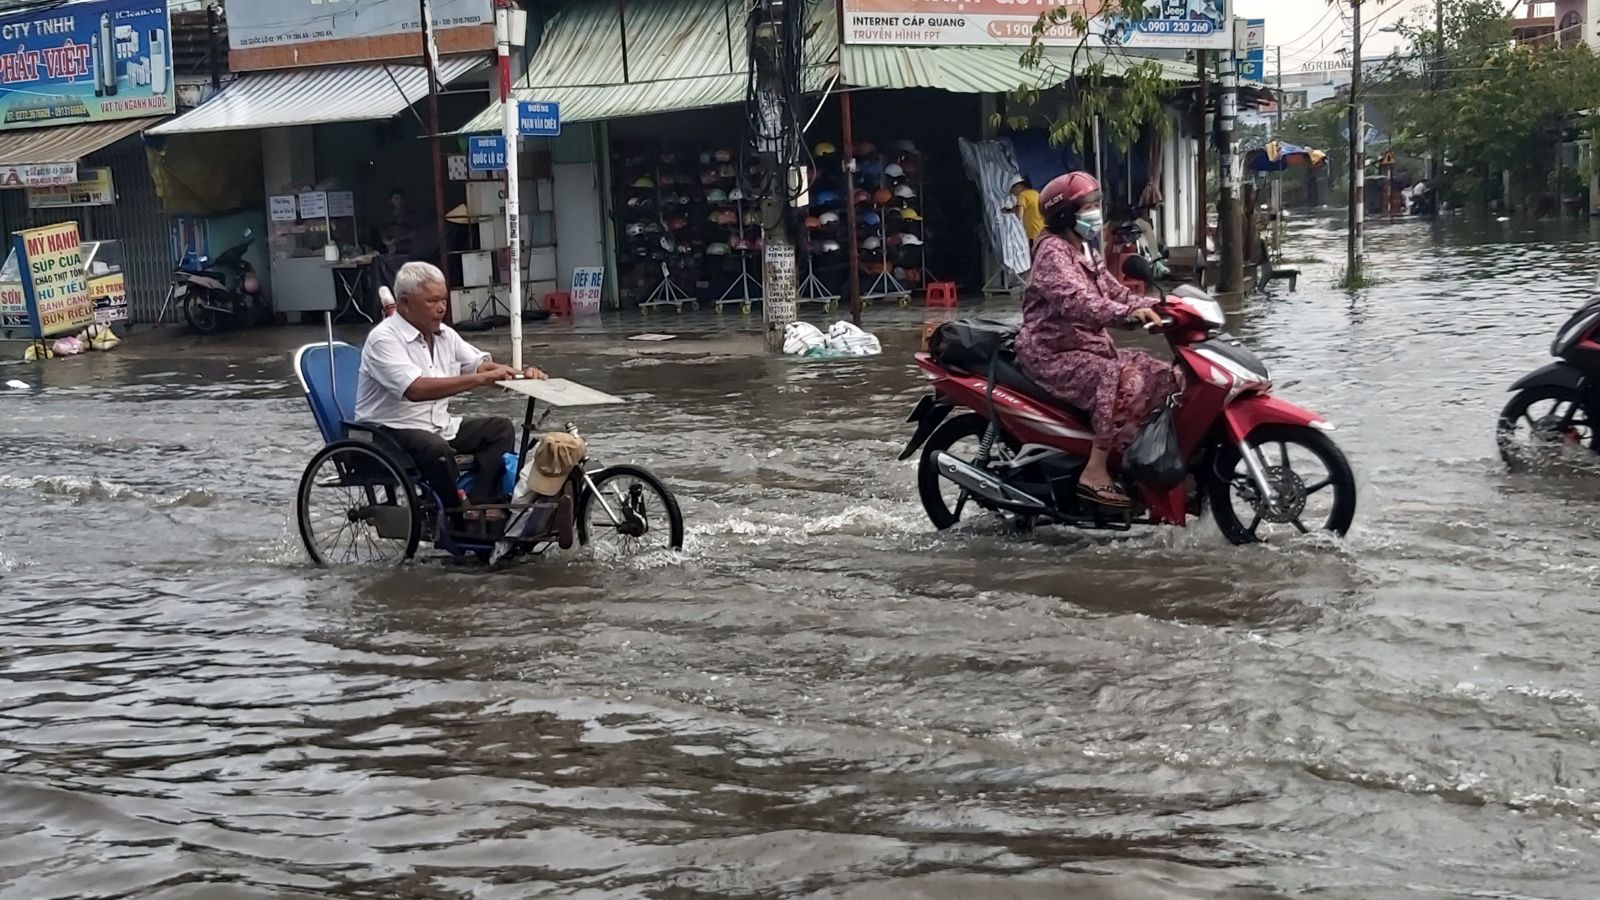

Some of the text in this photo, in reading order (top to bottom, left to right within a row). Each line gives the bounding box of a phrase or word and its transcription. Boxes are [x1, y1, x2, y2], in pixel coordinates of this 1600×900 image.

[1164, 6, 1184, 20] Jeep
[2, 15, 75, 40] CTY TNHH
[852, 17, 899, 27] INTERNET
[927, 18, 965, 28] QUANG
[1148, 21, 1208, 33] 0901 230 260
[923, 30, 941, 40] FPT
[43, 38, 90, 85] VIỆT
[472, 150, 504, 166] QUỐC LỘ 62
[27, 230, 78, 257] MỸ HẠNH
[32, 253, 81, 274] SÚP CUA
[67, 293, 90, 306] CANH
[573, 289, 599, 299] 15-20
